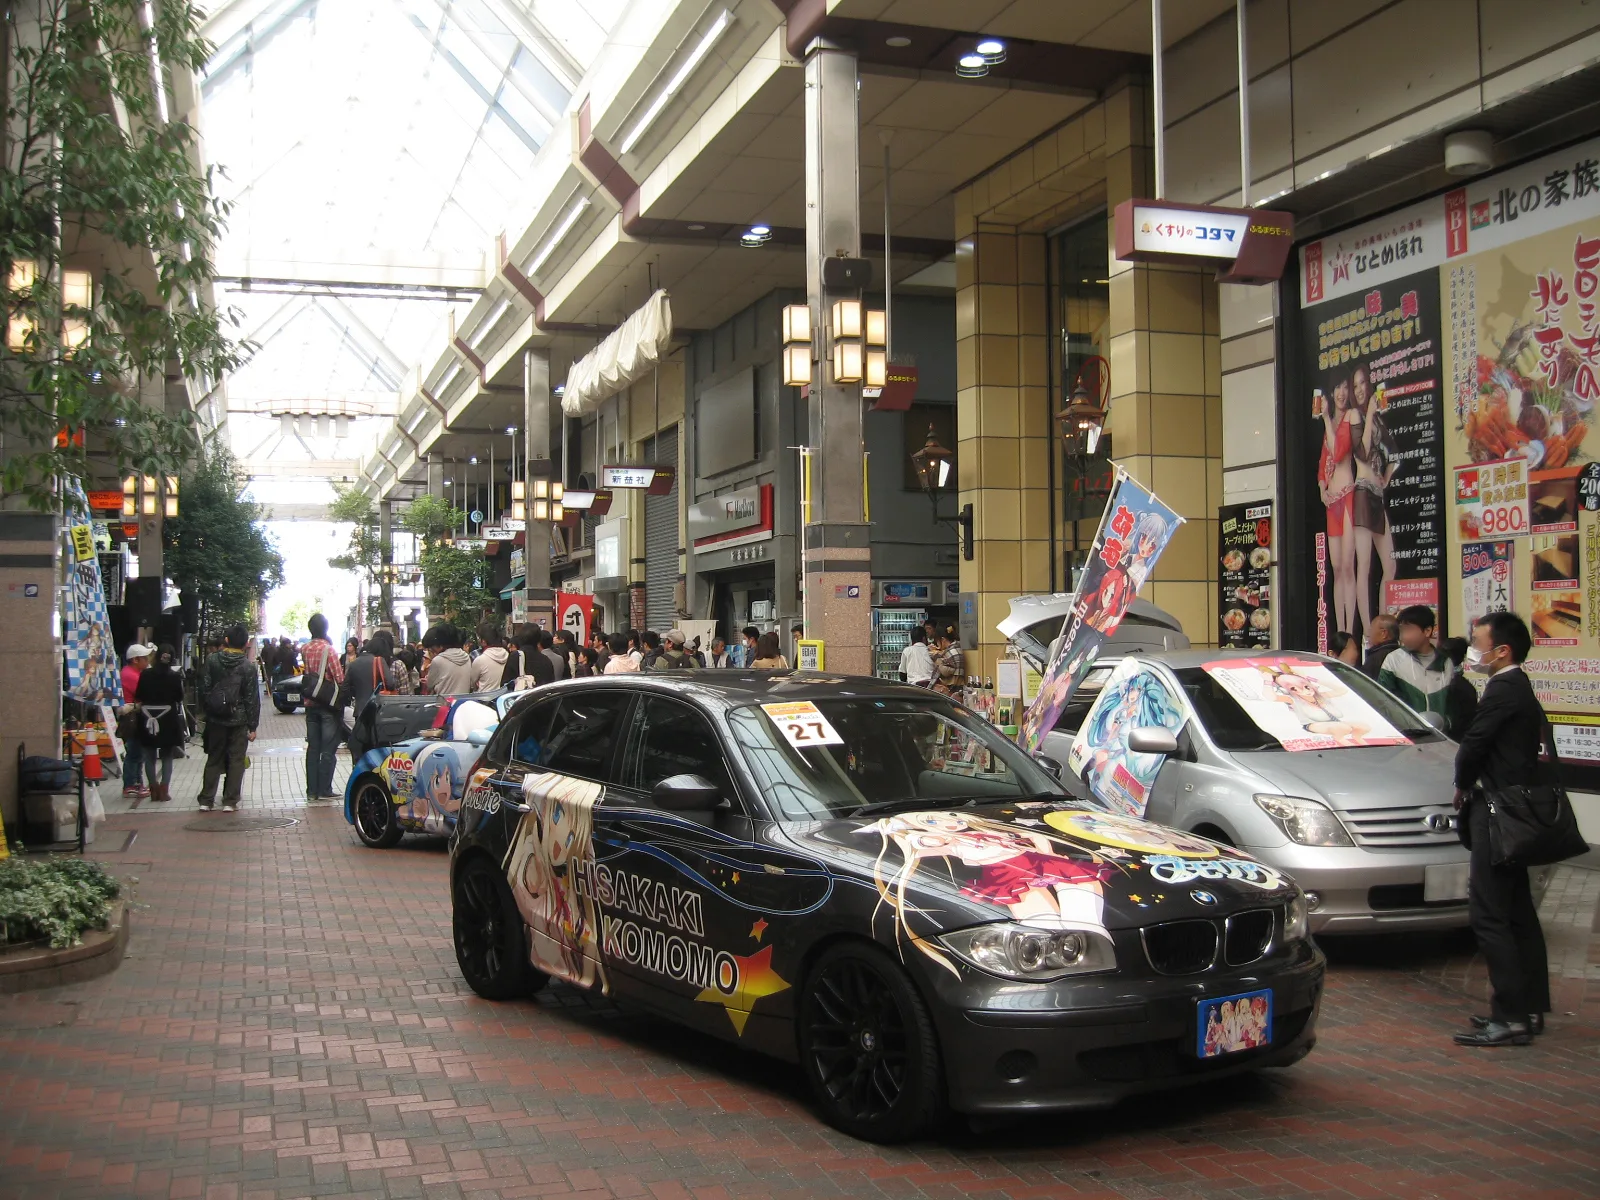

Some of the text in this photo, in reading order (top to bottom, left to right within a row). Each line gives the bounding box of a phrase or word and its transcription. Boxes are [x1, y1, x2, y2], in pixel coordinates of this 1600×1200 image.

[1493, 159, 1600, 225] 北の家族
[1249, 224, 1290, 236] ふるまちモール
[1450, 209, 1462, 253] B1
[1354, 235, 1423, 274] ひとめぼれ
[1308, 260, 1319, 299] B2
[1531, 270, 1569, 388] 北にあり
[1388, 420, 1434, 436] シャカシャカポテト
[611, 475, 646, 485] 新益社
[1480, 461, 1521, 489] 2時間
[1236, 521, 1257, 534] こだわり
[787, 722, 826, 740] 27
[387, 758, 414, 771] NAC
[572, 855, 705, 937] HISAKAKI
[603, 914, 740, 997] KOMOMO
